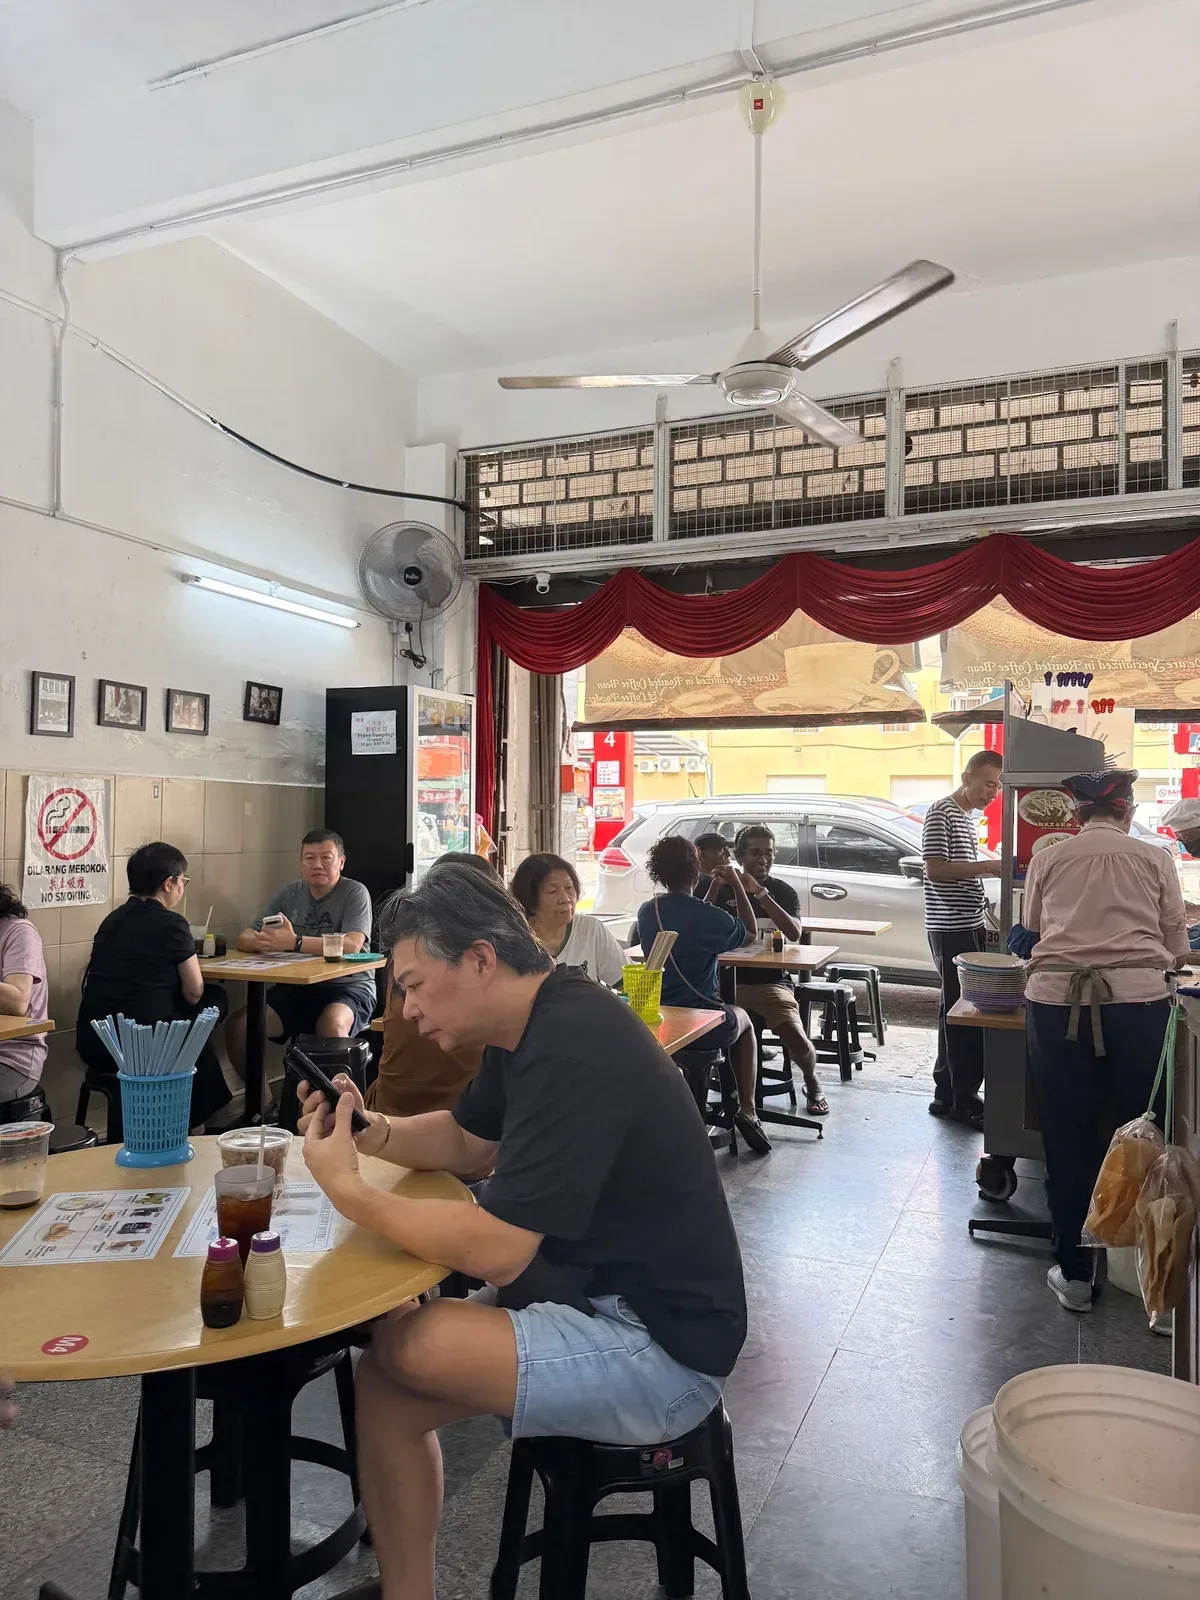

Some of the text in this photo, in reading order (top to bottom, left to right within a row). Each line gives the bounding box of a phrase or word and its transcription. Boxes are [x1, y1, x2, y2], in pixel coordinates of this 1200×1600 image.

[603, 731, 616, 748] 4
[27, 863, 107, 876] DILARANG MEROKOK
[41, 890, 91, 903] NO SMOKING
[987, 931, 1000, 943] 30
[47, 1336, 83, 1353] M4
